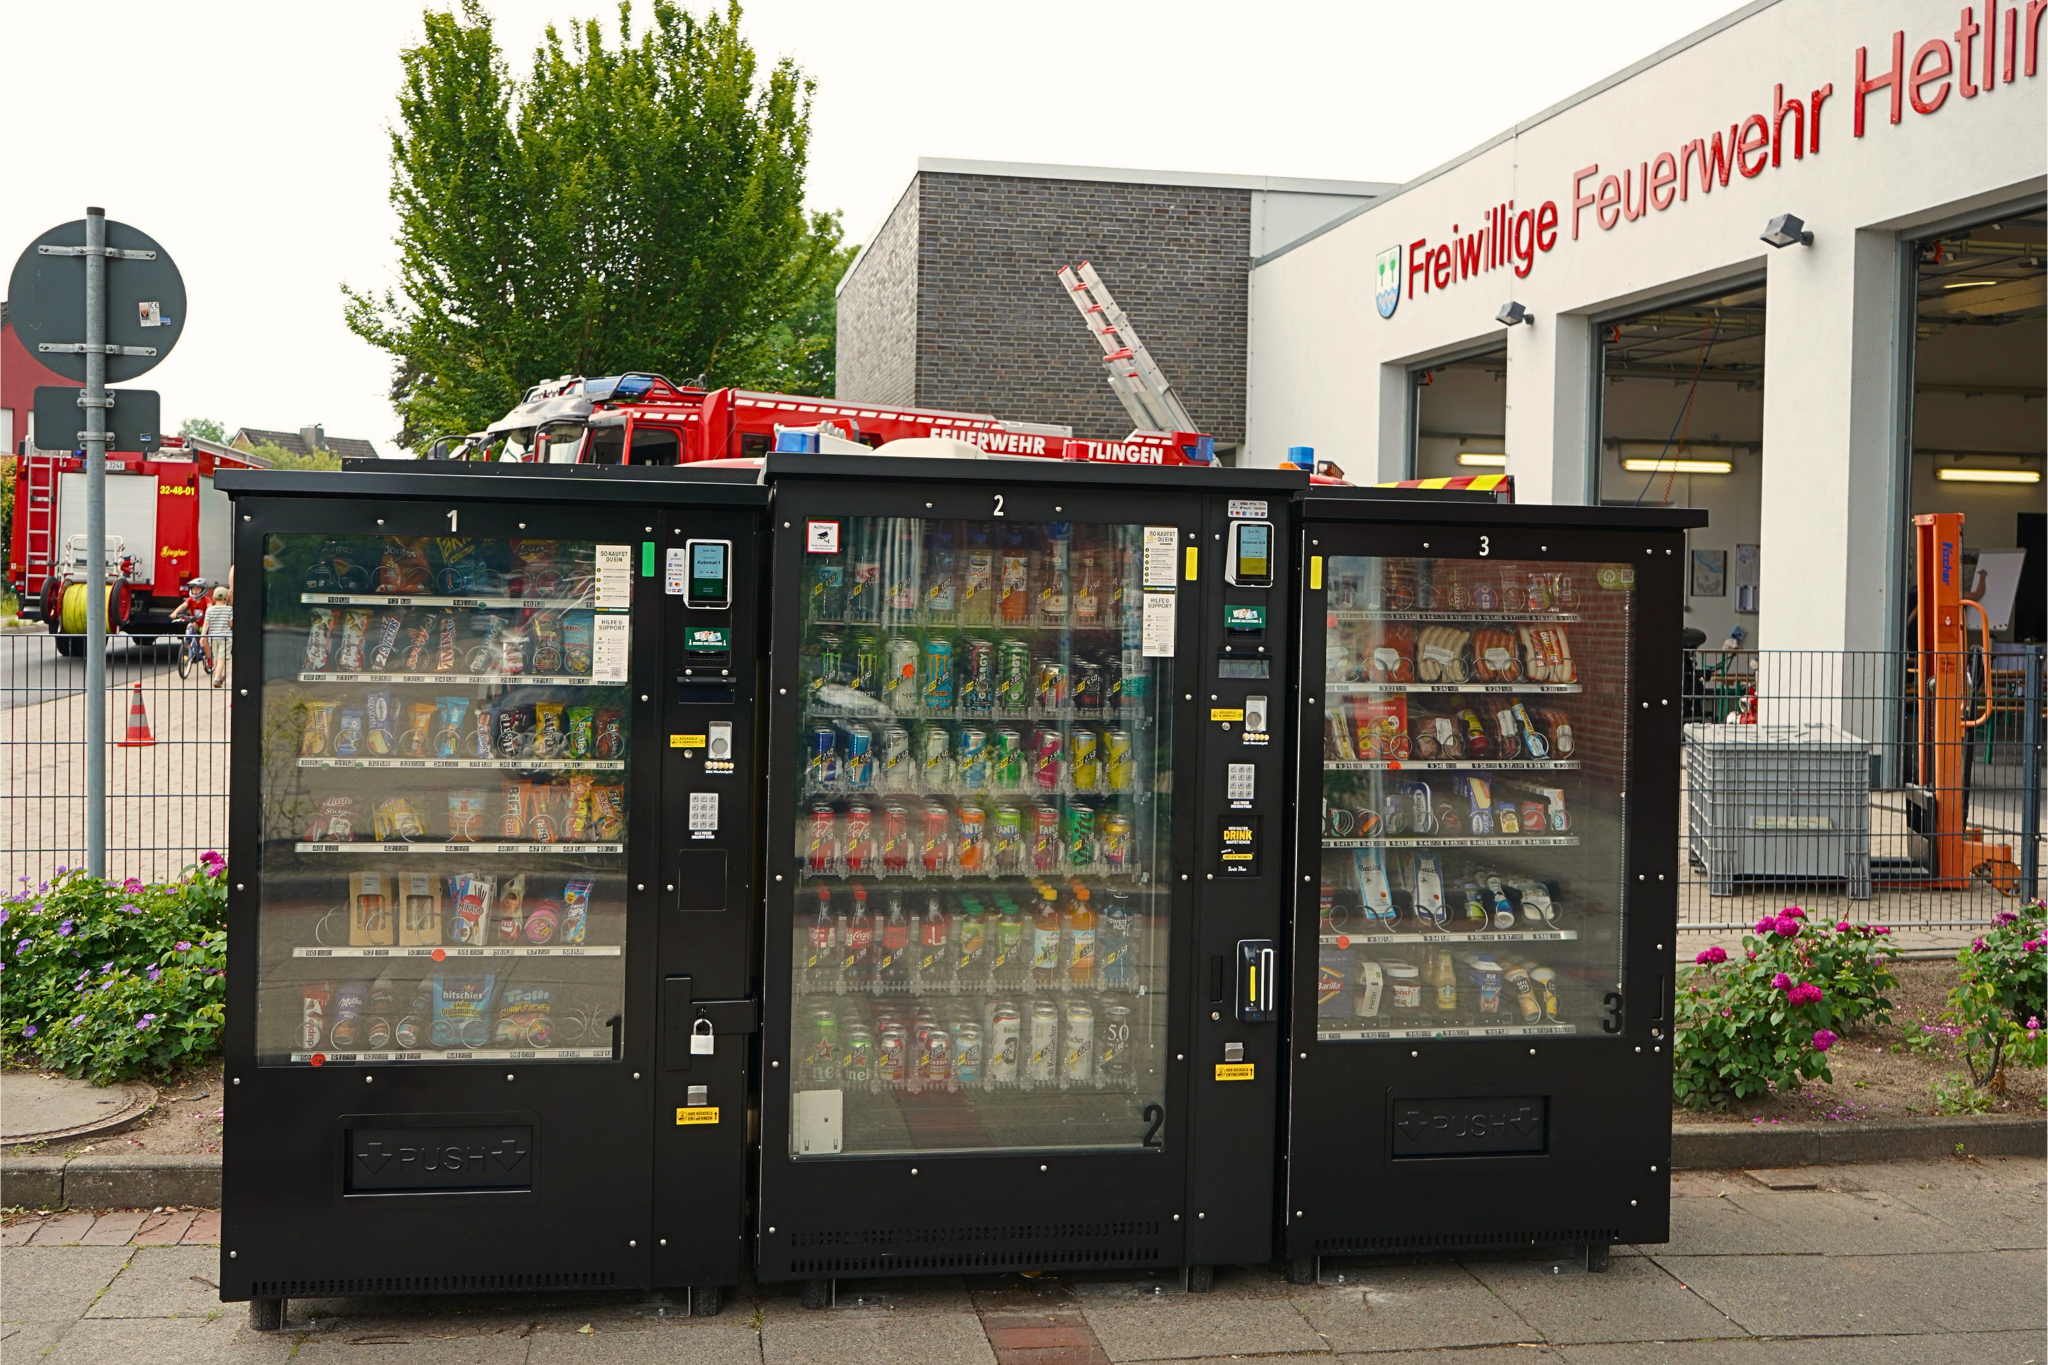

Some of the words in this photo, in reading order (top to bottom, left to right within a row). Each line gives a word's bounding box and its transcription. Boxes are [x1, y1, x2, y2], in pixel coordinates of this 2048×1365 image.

[1406, 198, 1559, 300] Freiwillige
[1570, 81, 1833, 241] Feuerwehr
[929, 427, 1046, 455] FEUERWEHR
[1062, 439, 1164, 464] TLINGEN
[160, 485, 195, 496] 32-48-01
[992, 494, 1004, 516] 2
[446, 509, 458, 533] 1
[608, 550, 629, 558] KAUFST
[1479, 535, 1490, 557] 3
[1481, 584, 1491, 610] OCB
[378, 617, 400, 657] SNICKERS
[577, 720, 587, 755] Skittles
[507, 785, 522, 816] BiFi
[505, 816, 517, 838] Roll
[1223, 829, 1253, 841] DRINK
[458, 902, 485, 916] MIKADO
[442, 990, 484, 1001] hitschies
[504, 988, 550, 1002] Trolli
[1602, 992, 1624, 1034] 3
[305, 1017, 317, 1048] duplo
[606, 1014, 622, 1061] 1
[1143, 1104, 1165, 1148] 2
[1432, 1114, 1507, 1139] PUSH
[399, 1146, 487, 1172] PUSH
